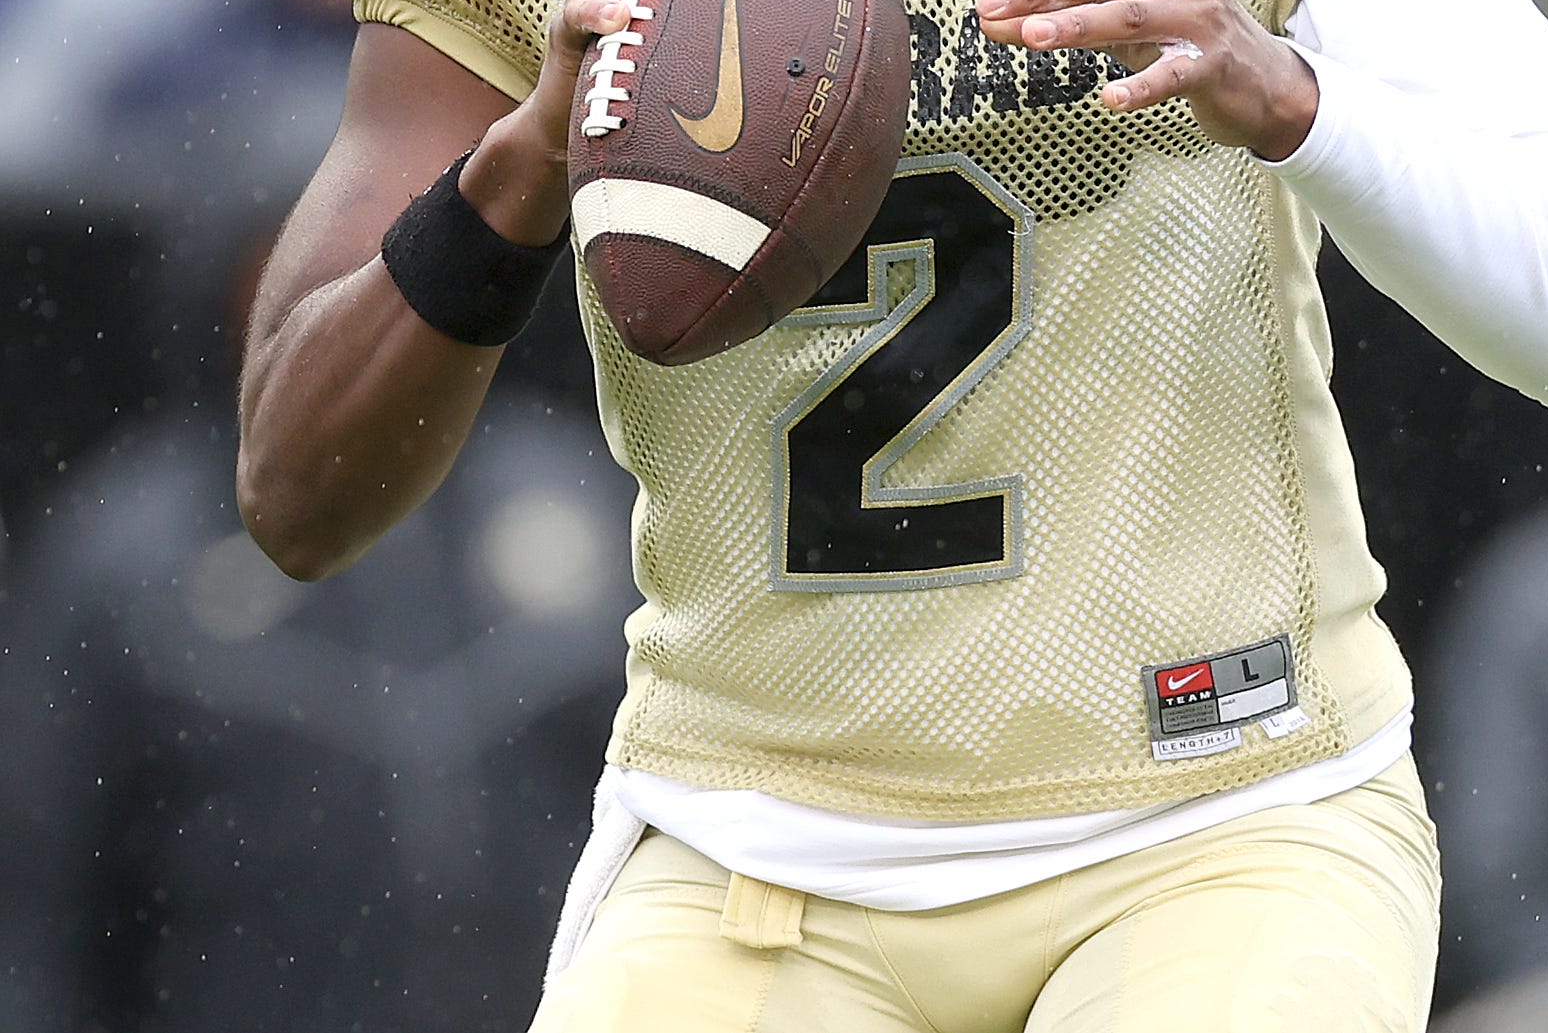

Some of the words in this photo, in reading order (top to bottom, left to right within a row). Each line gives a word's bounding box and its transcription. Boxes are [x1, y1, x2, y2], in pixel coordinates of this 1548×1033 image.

[781, 74, 835, 169] VAPOR
[769, 150, 1035, 593] 2
[1165, 690, 1212, 706] TEAM
[1241, 659, 1259, 683] L
